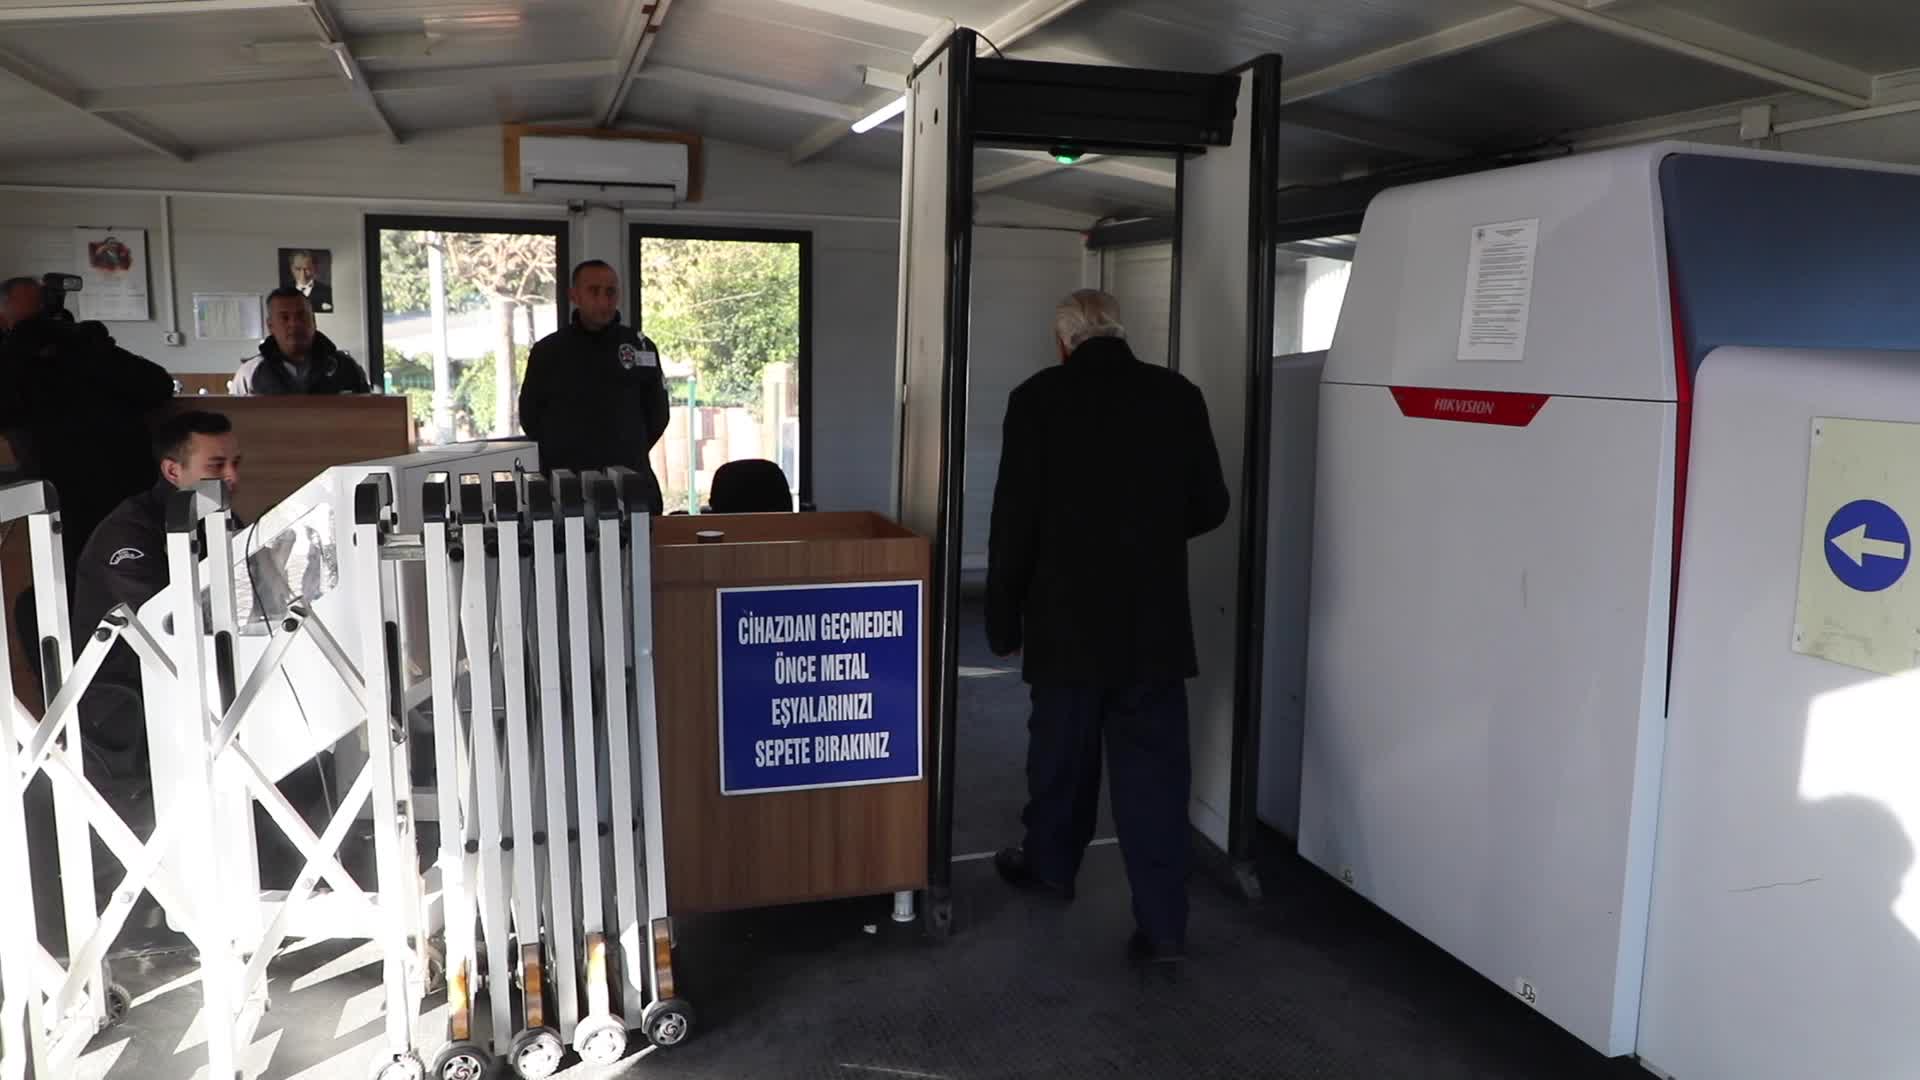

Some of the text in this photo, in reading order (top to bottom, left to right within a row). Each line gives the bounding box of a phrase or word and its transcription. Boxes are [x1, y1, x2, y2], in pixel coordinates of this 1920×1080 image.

[1434, 398, 1495, 415] HIKVISION
[738, 610, 903, 645] CİHAZDAN GEÇMEDEN
[774, 651, 870, 685] ÖNCE METAL
[771, 692, 873, 728] EŞYALARINIZI
[755, 731, 890, 768] SEPETE BIRAKINIZ
